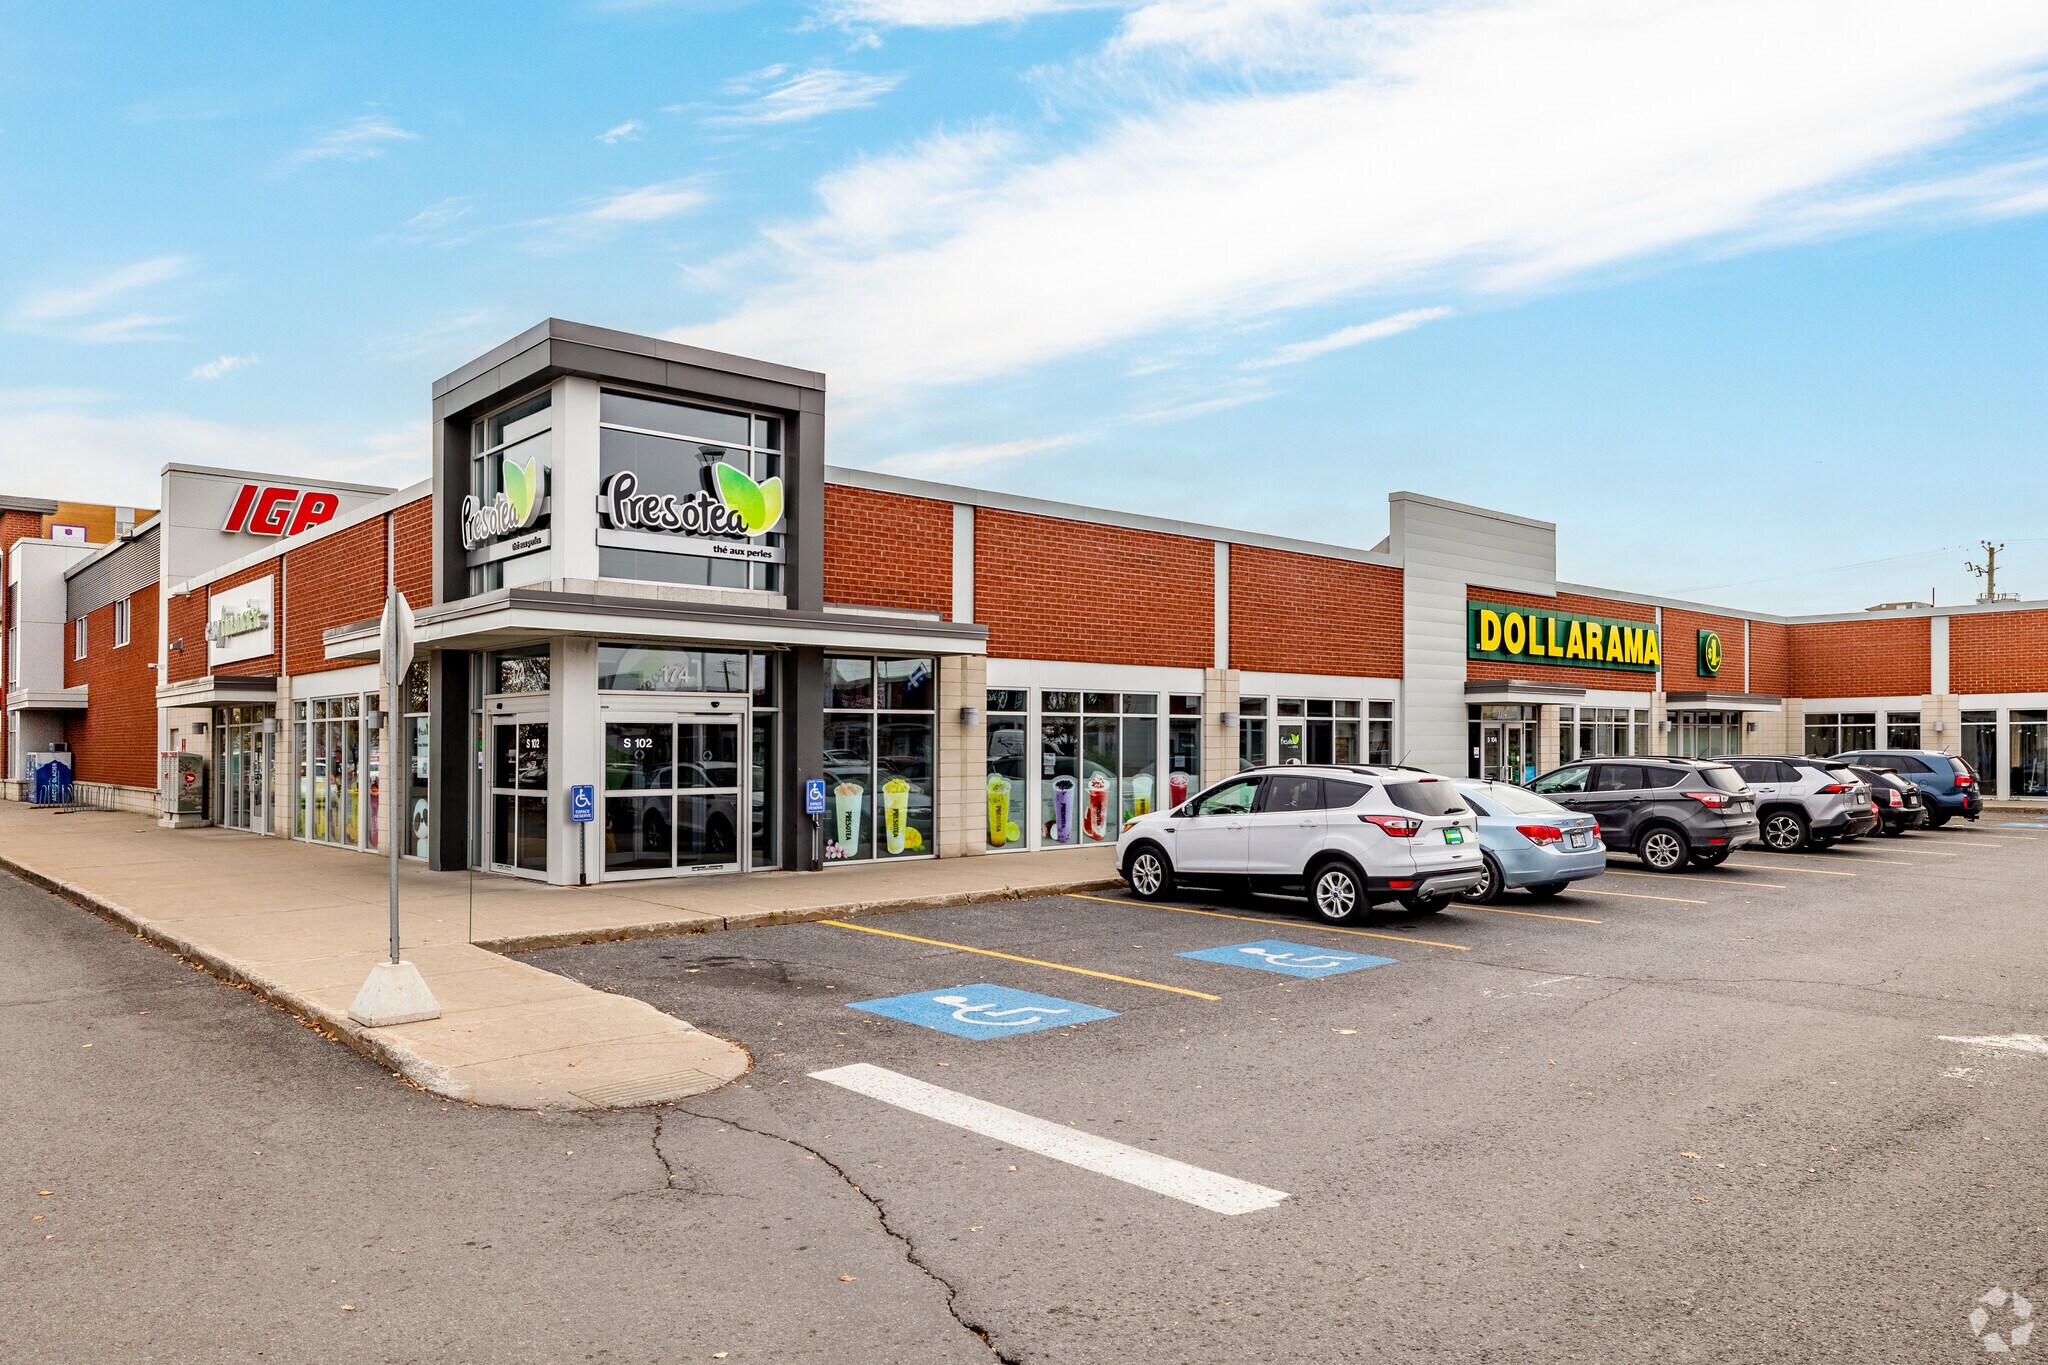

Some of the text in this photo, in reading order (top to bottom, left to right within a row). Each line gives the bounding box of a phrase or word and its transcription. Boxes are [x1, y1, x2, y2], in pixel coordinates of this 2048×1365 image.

[221, 484, 339, 536] IGA
[609, 471, 749, 534] Presotea
[462, 493, 520, 550] Presotea
[713, 544, 772, 559] thé aux perles
[1480, 609, 1660, 665] DOLLARAMA
[660, 664, 690, 684] 174
[526, 739, 540, 748] S 102
[623, 738, 653, 748] S 102
